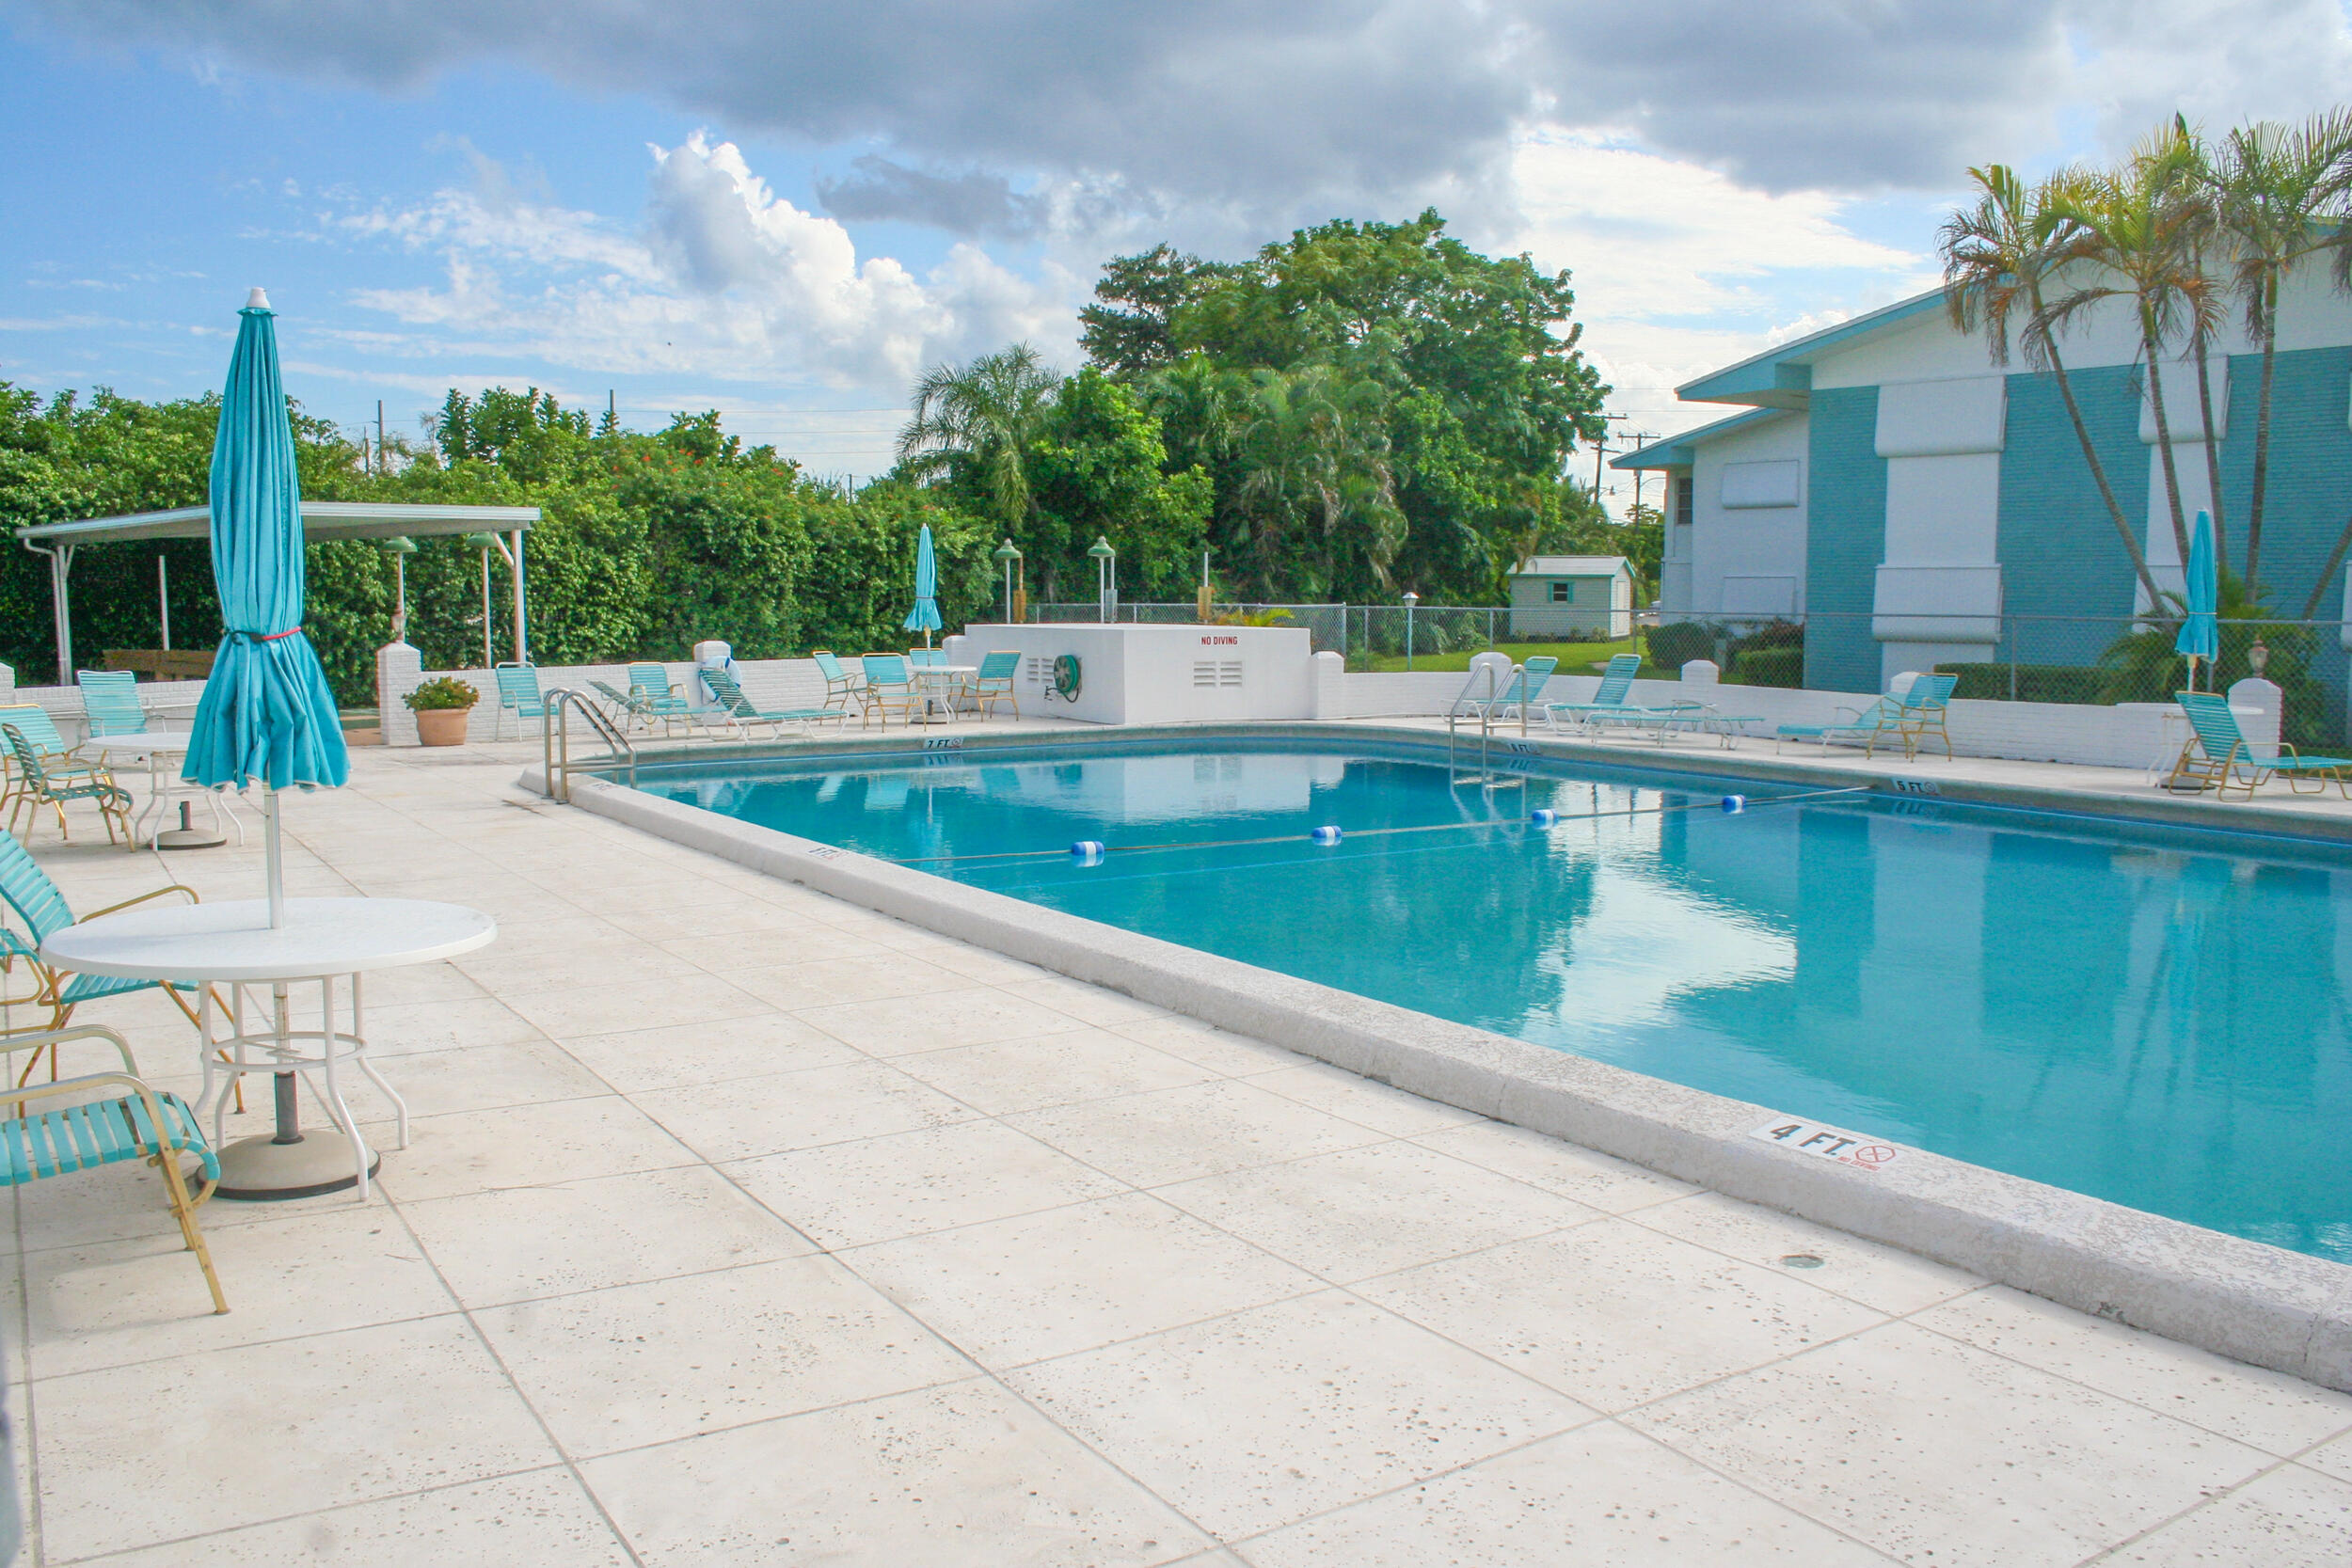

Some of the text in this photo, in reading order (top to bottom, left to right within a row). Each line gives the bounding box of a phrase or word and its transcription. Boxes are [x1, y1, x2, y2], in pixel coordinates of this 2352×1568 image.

[1201, 636, 1238, 645] NO DIVING
[928, 739, 934, 749] 7
[1896, 780, 1906, 791] 5
[1770, 1124, 1857, 1156] 4 FT.
